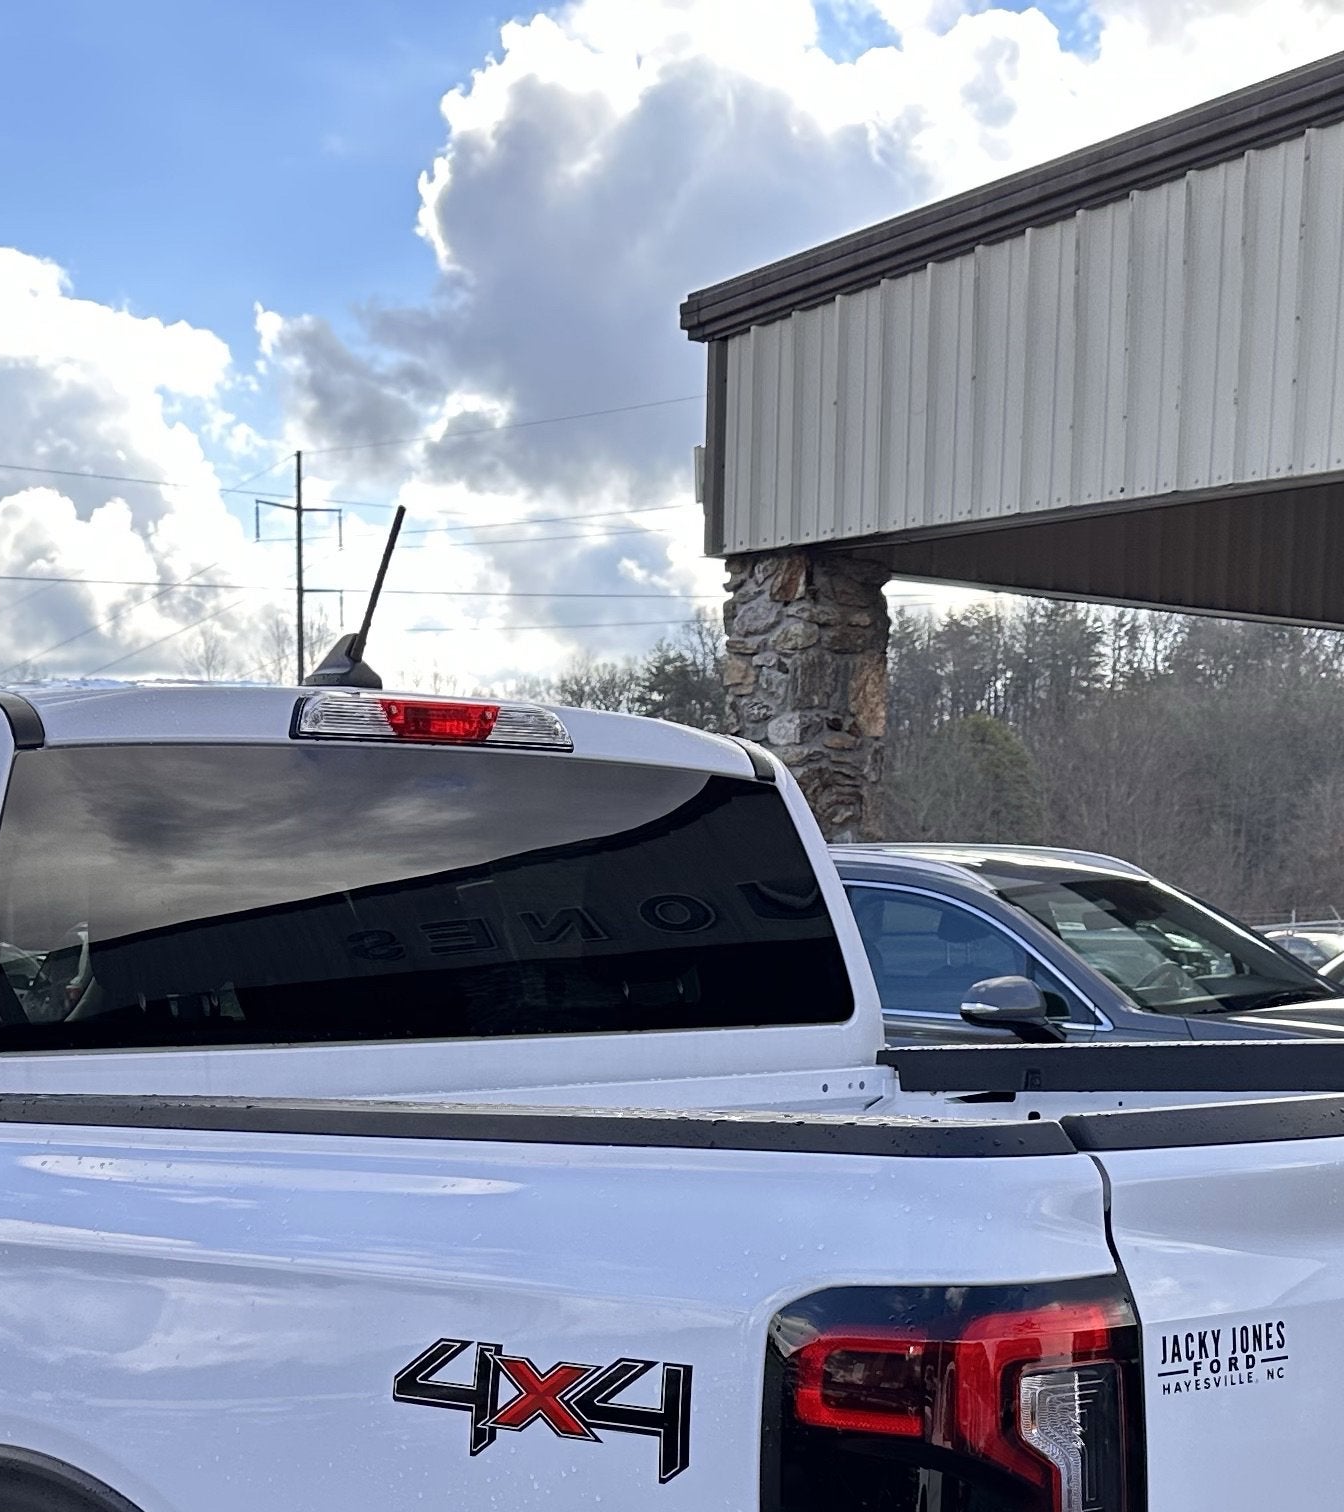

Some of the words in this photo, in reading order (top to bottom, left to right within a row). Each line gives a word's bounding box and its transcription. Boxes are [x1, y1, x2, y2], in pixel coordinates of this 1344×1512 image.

[1161, 1329, 1221, 1365] JACKY
[1231, 1320, 1286, 1355] JONES
[1193, 1354, 1256, 1376] FORD
[1266, 1366, 1285, 1381] NC
